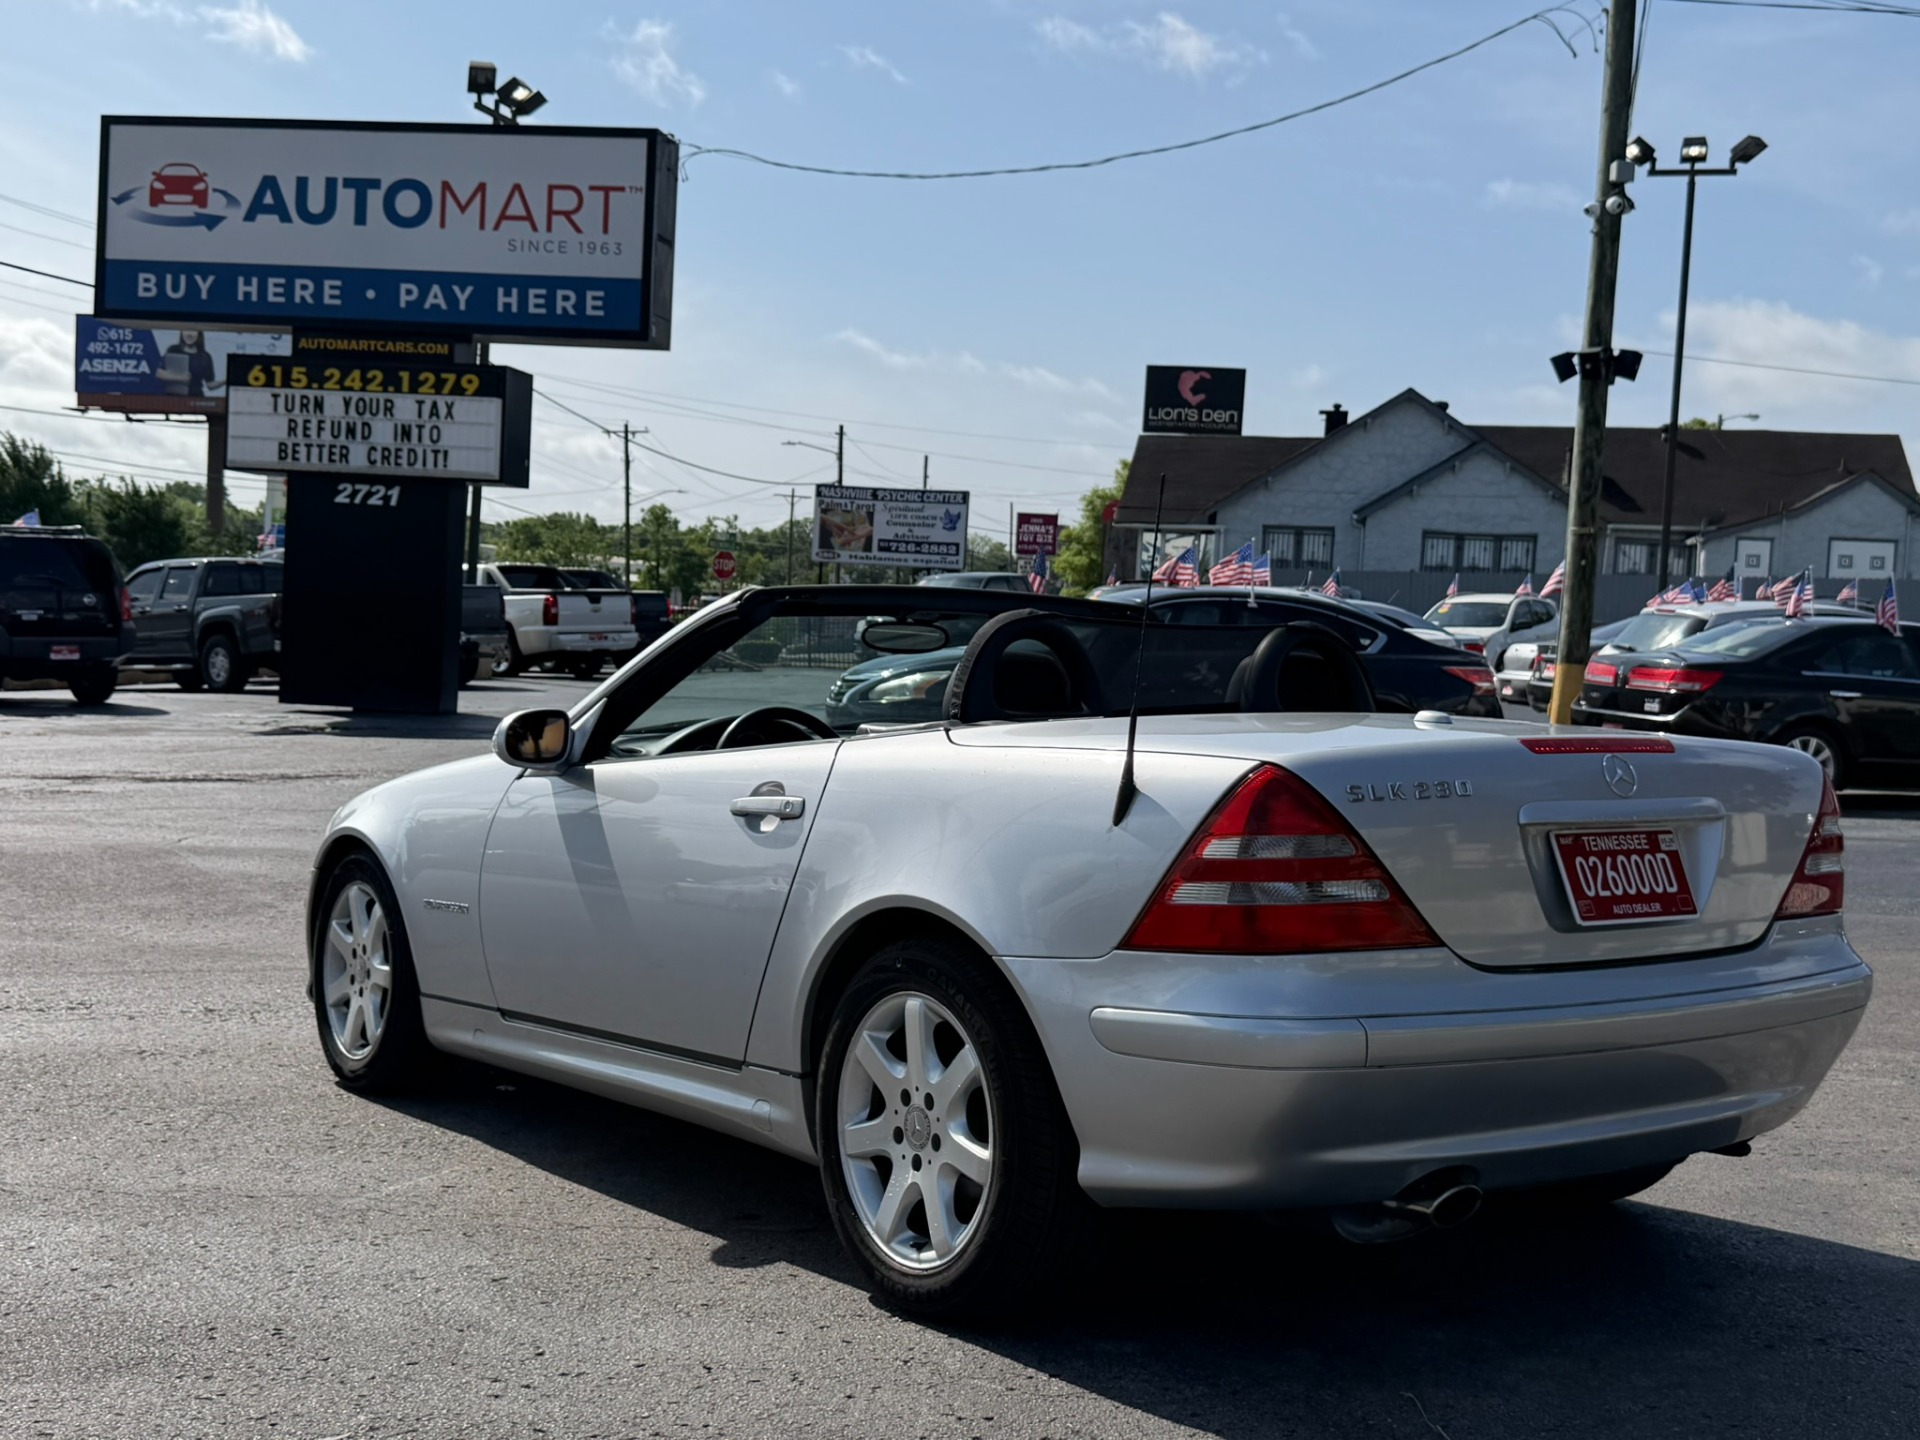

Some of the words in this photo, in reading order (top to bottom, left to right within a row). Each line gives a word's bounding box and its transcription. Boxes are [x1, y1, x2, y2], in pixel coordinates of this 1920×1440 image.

[242, 174, 626, 235] AUTOMART
[507, 238, 568, 254] SINCE
[578, 241, 623, 256] 1963
[136, 272, 216, 300] BUY
[237, 276, 343, 306] HERE
[399, 282, 475, 311] PAY
[496, 286, 606, 316] HERE
[110, 329, 133, 341] 615
[87, 342, 144, 355] 492-1472
[298, 338, 449, 355] AUTOMARTCARS.COM
[79, 358, 151, 374] ASENZA
[247, 364, 481, 396] 615.242.1279
[271, 393, 325, 414] TURN
[342, 396, 395, 418] YOUR
[415, 399, 456, 420] TAX
[287, 418, 373, 441] REFUND
[394, 423, 442, 444] INTO
[277, 441, 350, 464] BETTER
[366, 446, 449, 469] CREDIT!
[334, 482, 401, 507] 2721
[876, 489, 922, 502] PSYCHIC
[923, 492, 965, 504] CENTER
[889, 541, 957, 555] 726-2882
[713, 558, 735, 570] STOP
[1344, 783, 1408, 802] SLK
[1413, 779, 1473, 801] 230
[1581, 834, 1650, 852] TENNESSEE
[1575, 852, 1679, 898] 026000D
[1612, 904, 1632, 915] AUTO
[1633, 903, 1662, 914] DEALER
